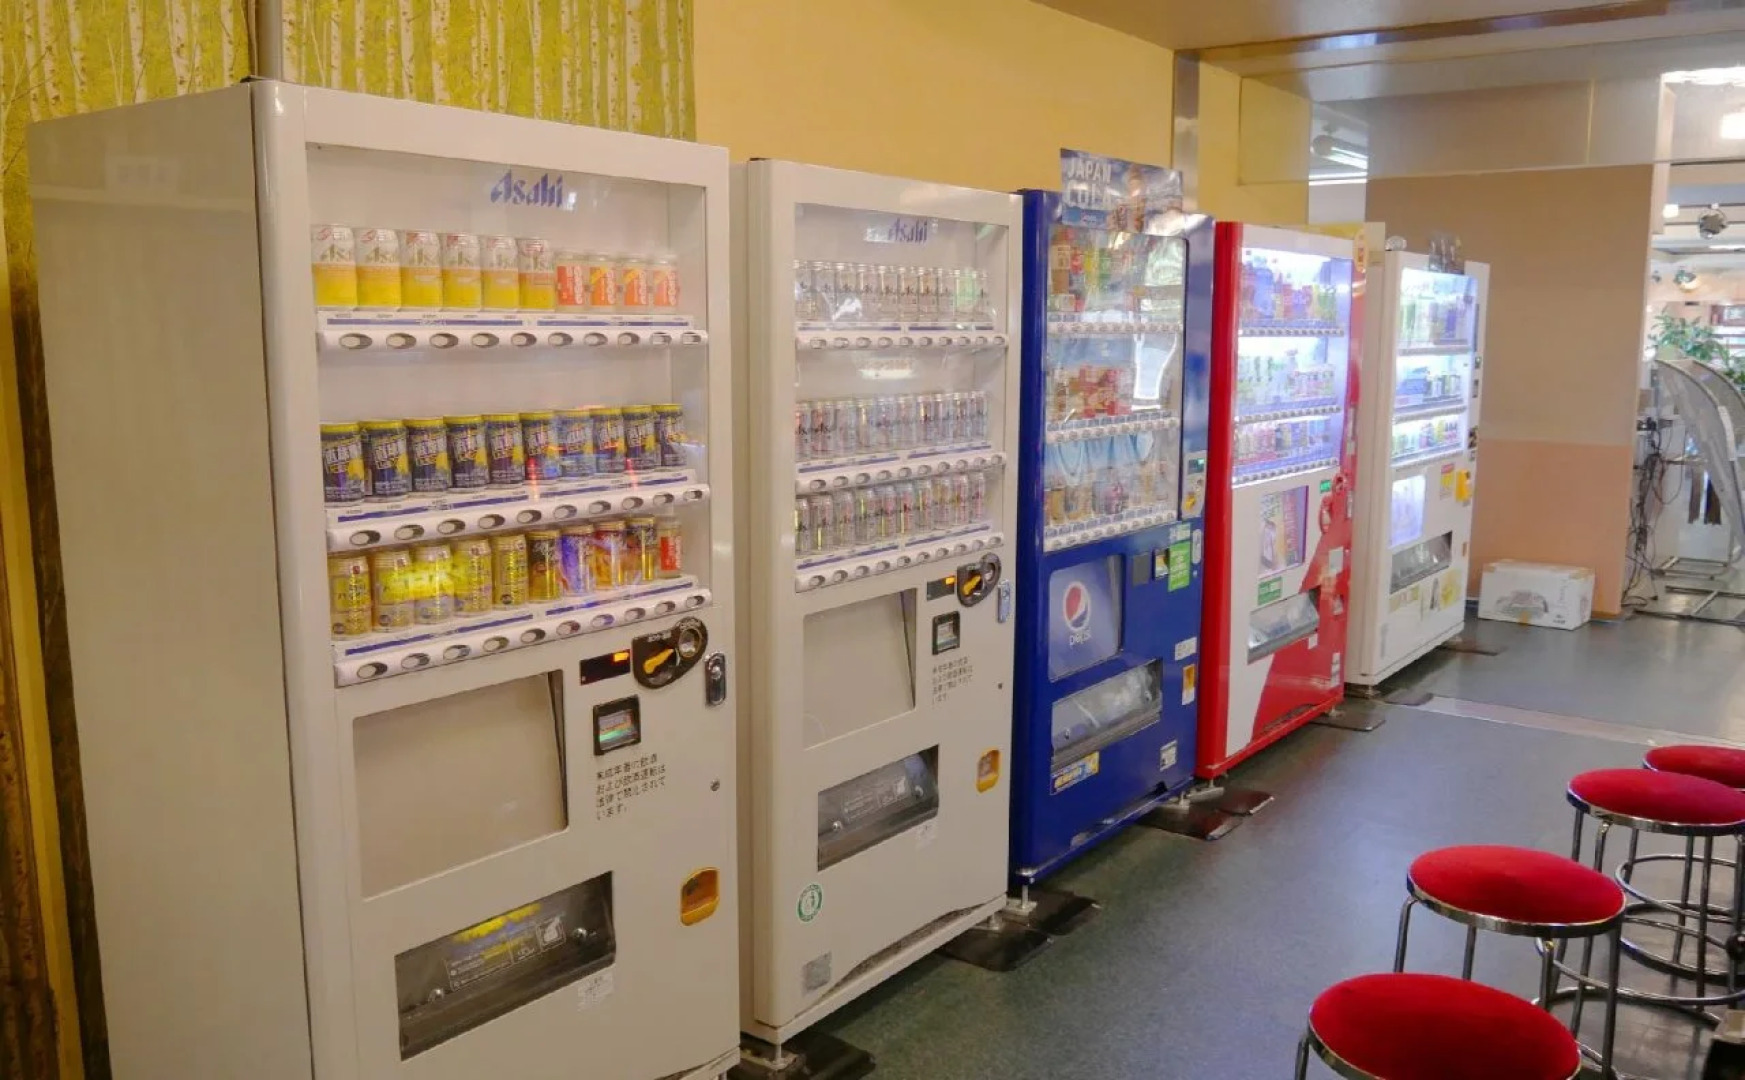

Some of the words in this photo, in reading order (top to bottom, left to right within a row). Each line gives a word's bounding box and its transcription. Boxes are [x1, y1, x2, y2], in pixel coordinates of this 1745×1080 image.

[1067, 158, 1112, 184] JAPAN
[490, 169, 563, 208] Asahi
[1063, 179, 1113, 210] COLA
[887, 217, 928, 244] Asahi
